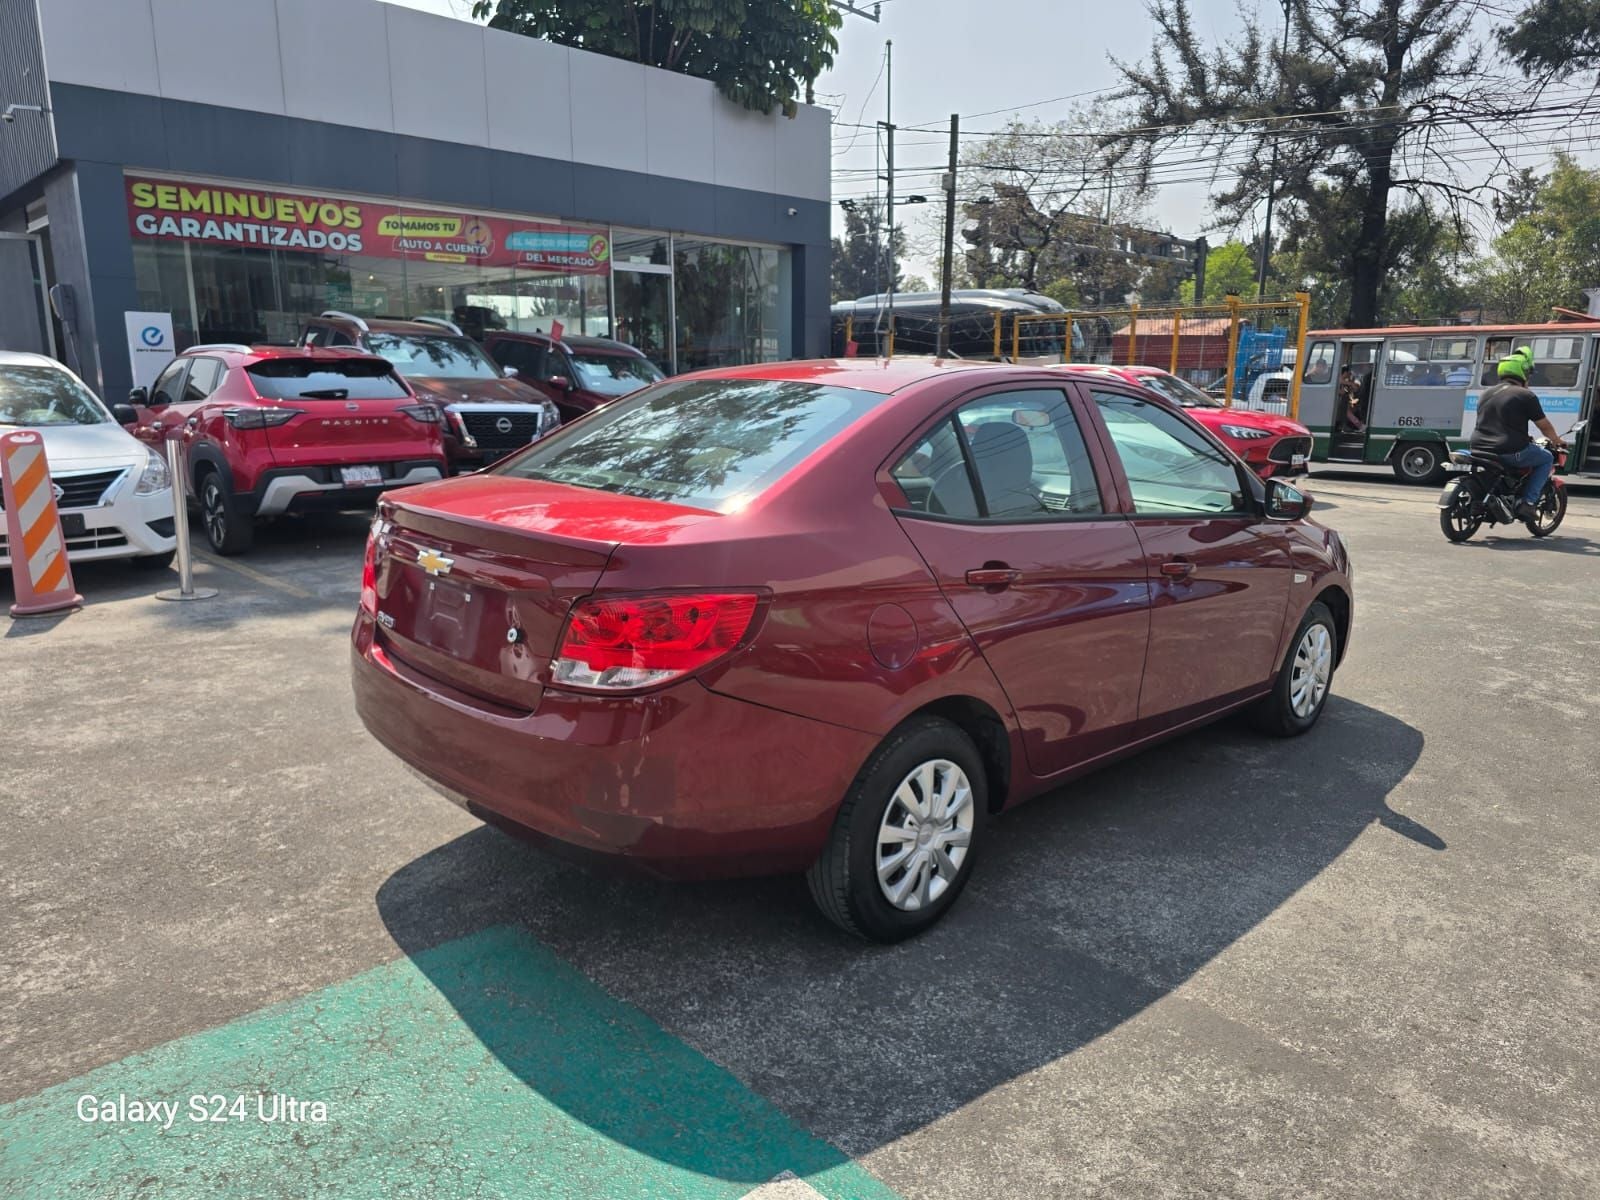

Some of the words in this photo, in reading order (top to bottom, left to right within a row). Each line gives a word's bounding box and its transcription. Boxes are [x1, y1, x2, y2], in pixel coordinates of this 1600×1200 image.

[131, 182, 363, 229] SEMINUEVOS
[135, 214, 363, 251] GARANTIZADOS
[385, 220, 441, 232] TOMAMOS
[442, 223, 456, 232] TU
[399, 239, 432, 250] AUTO
[434, 241, 444, 251] A
[445, 242, 489, 256] CUENTA
[526, 252, 545, 263] DEL
[547, 255, 595, 267] MERCADO
[321, 418, 389, 426] MAGNITE
